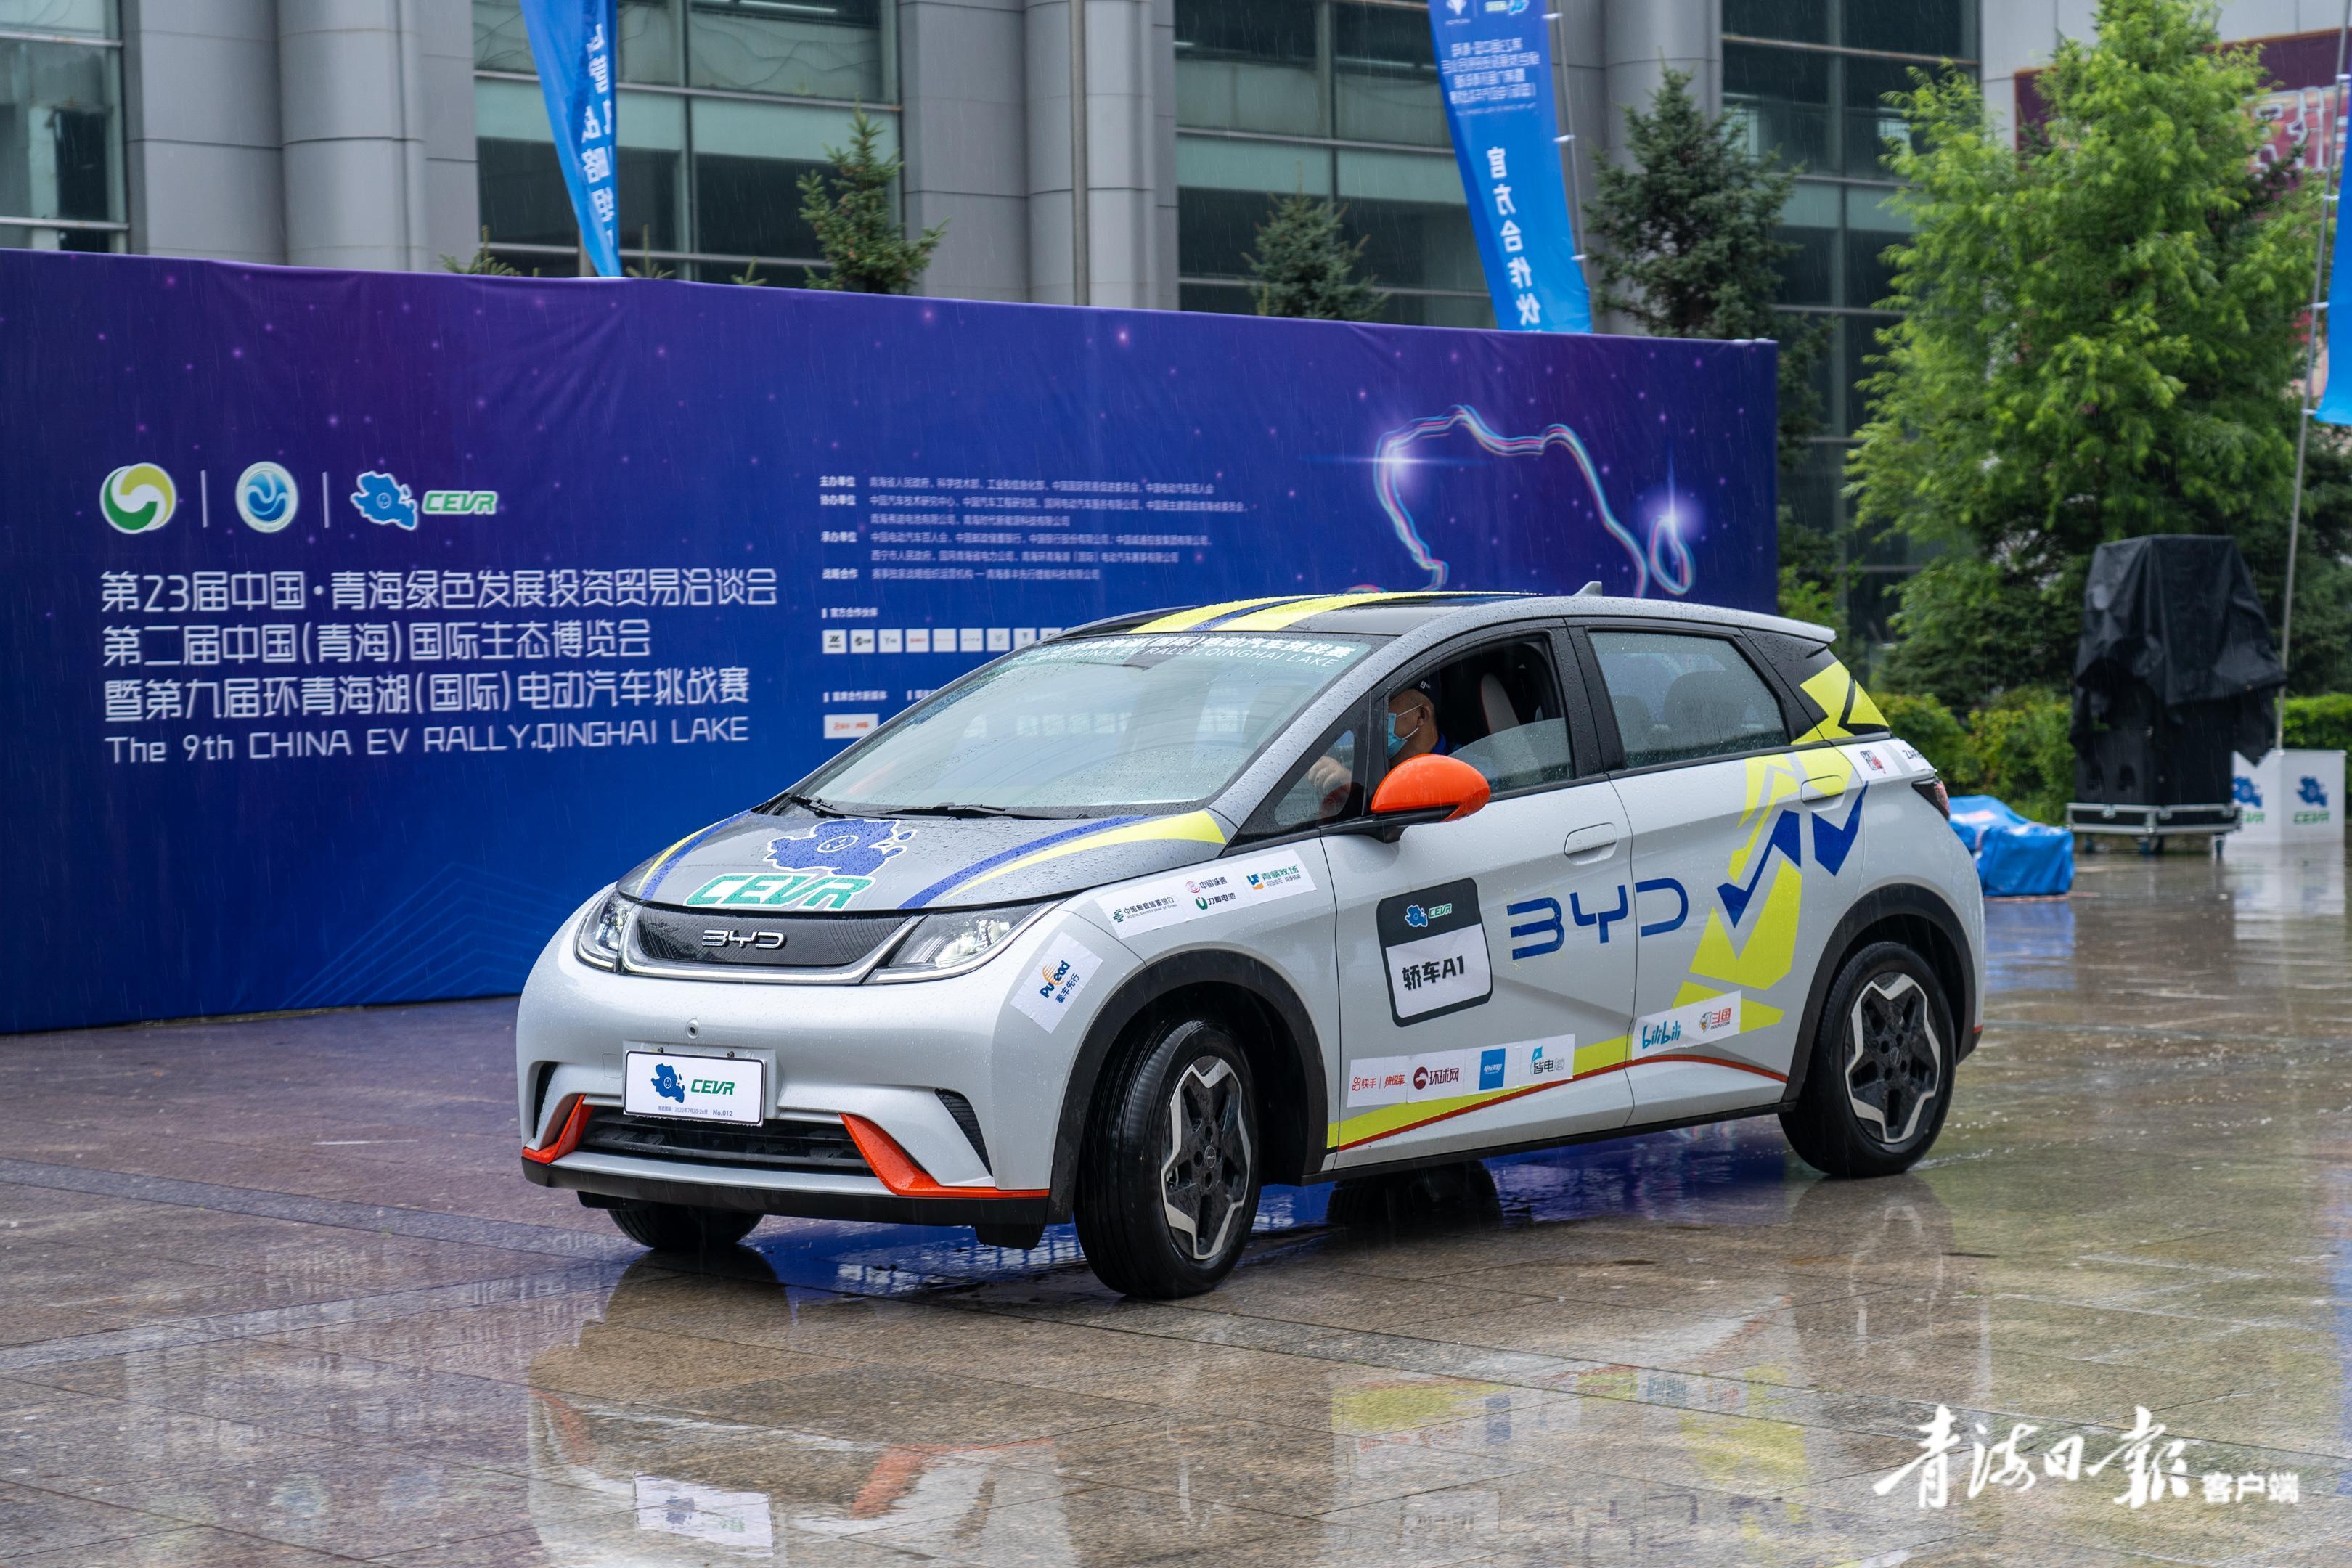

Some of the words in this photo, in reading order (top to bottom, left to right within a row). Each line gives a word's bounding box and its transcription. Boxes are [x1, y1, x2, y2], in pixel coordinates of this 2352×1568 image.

[423, 491, 497, 513] CEVR
[100, 568, 777, 613] 第23届中国·青海绿色发展投资贸易洽谈会
[102, 618, 651, 667] 第二届中国(青海)国际生态博览会
[1204, 648, 1281, 661] QINGHAI
[1286, 655, 1339, 667] LAKE
[104, 666, 750, 722] 暨第九届环青海湖(国际)电动汽车挑战赛
[104, 735, 167, 763] The
[182, 733, 234, 761] 9th
[249, 729, 353, 759] CHINA
[367, 727, 410, 756] EV
[671, 716, 750, 743] LAKE
[2293, 811, 2330, 825] CEVR
[686, 874, 874, 910] CEVR
[1428, 903, 1453, 919] CEVR
[1506, 877, 1689, 960] BYD
[702, 928, 787, 950] BYD
[1055, 972, 1080, 1004] 泰丰先行
[1402, 954, 1466, 992] 轿车A1
[1642, 1020, 1681, 1050] bilibili
[690, 1079, 735, 1095] CEVR
[1361, 1077, 1377, 1089] 快手
[1429, 1067, 1460, 1085] 环球网
